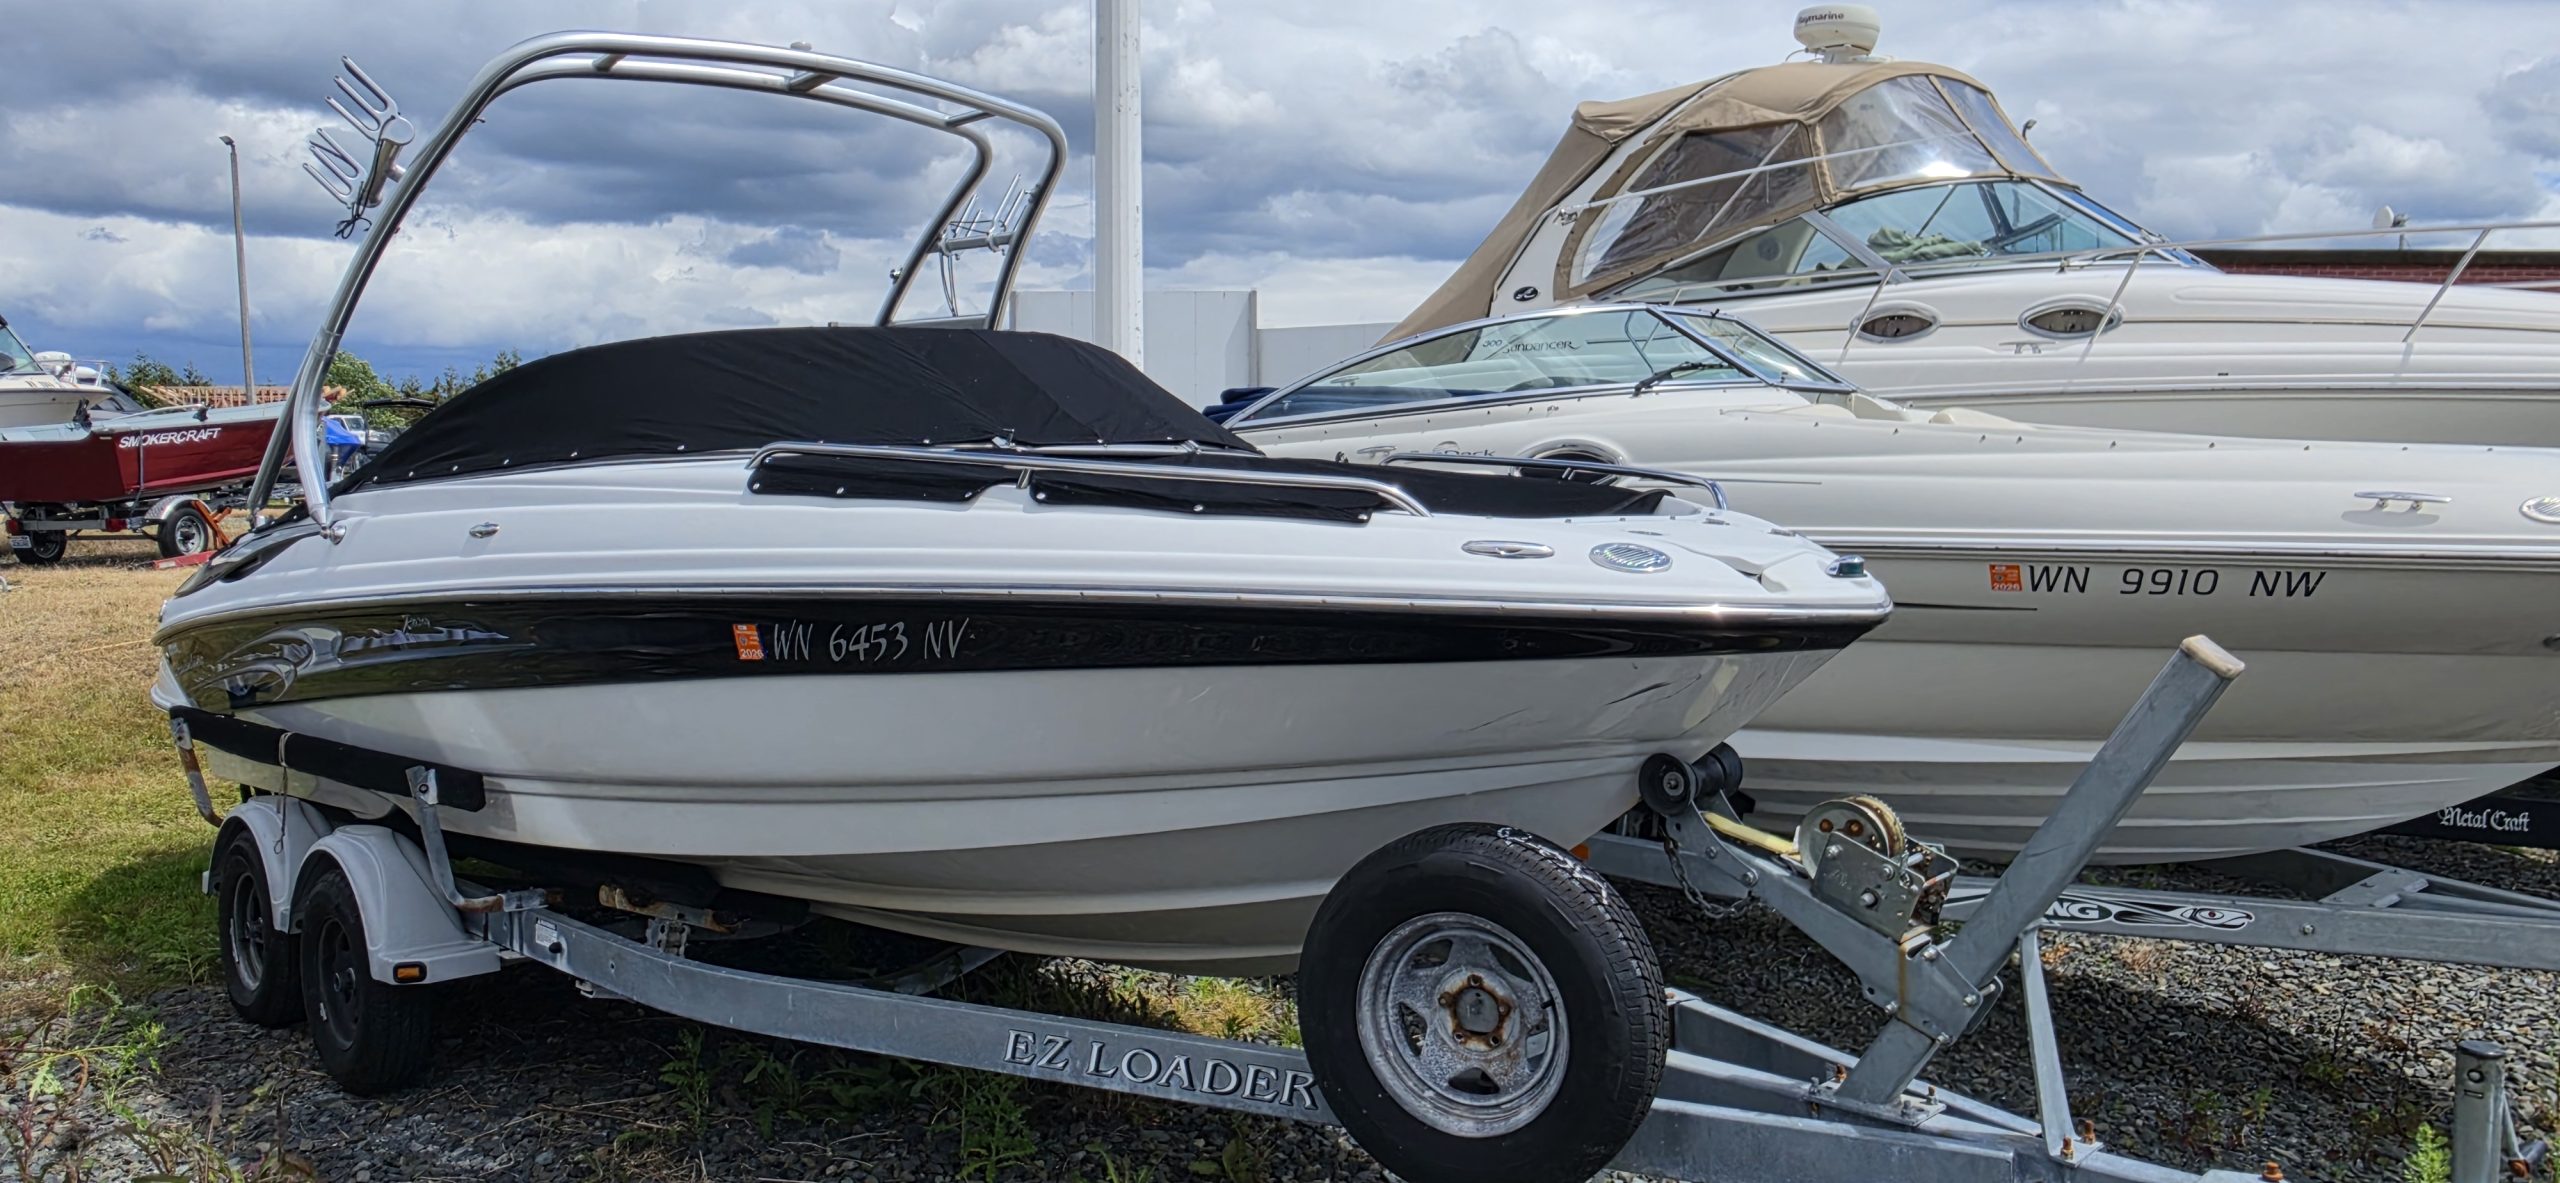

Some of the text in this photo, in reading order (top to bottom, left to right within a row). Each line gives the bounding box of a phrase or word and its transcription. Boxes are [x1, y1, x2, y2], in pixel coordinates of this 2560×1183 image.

[119, 428, 222, 448] SMOKERCRAFT
[2029, 565, 2090, 592] WN
[2120, 568, 2219, 595] 9910
[2249, 570, 2327, 597] NW
[773, 619, 814, 661] WN
[829, 621, 909, 662] 6453
[924, 617, 970, 659] NV
[2438, 807, 2530, 832] Metal Craft
[2045, 900, 2100, 919] NG
[1003, 1028, 1320, 1110] EZ LOADER
